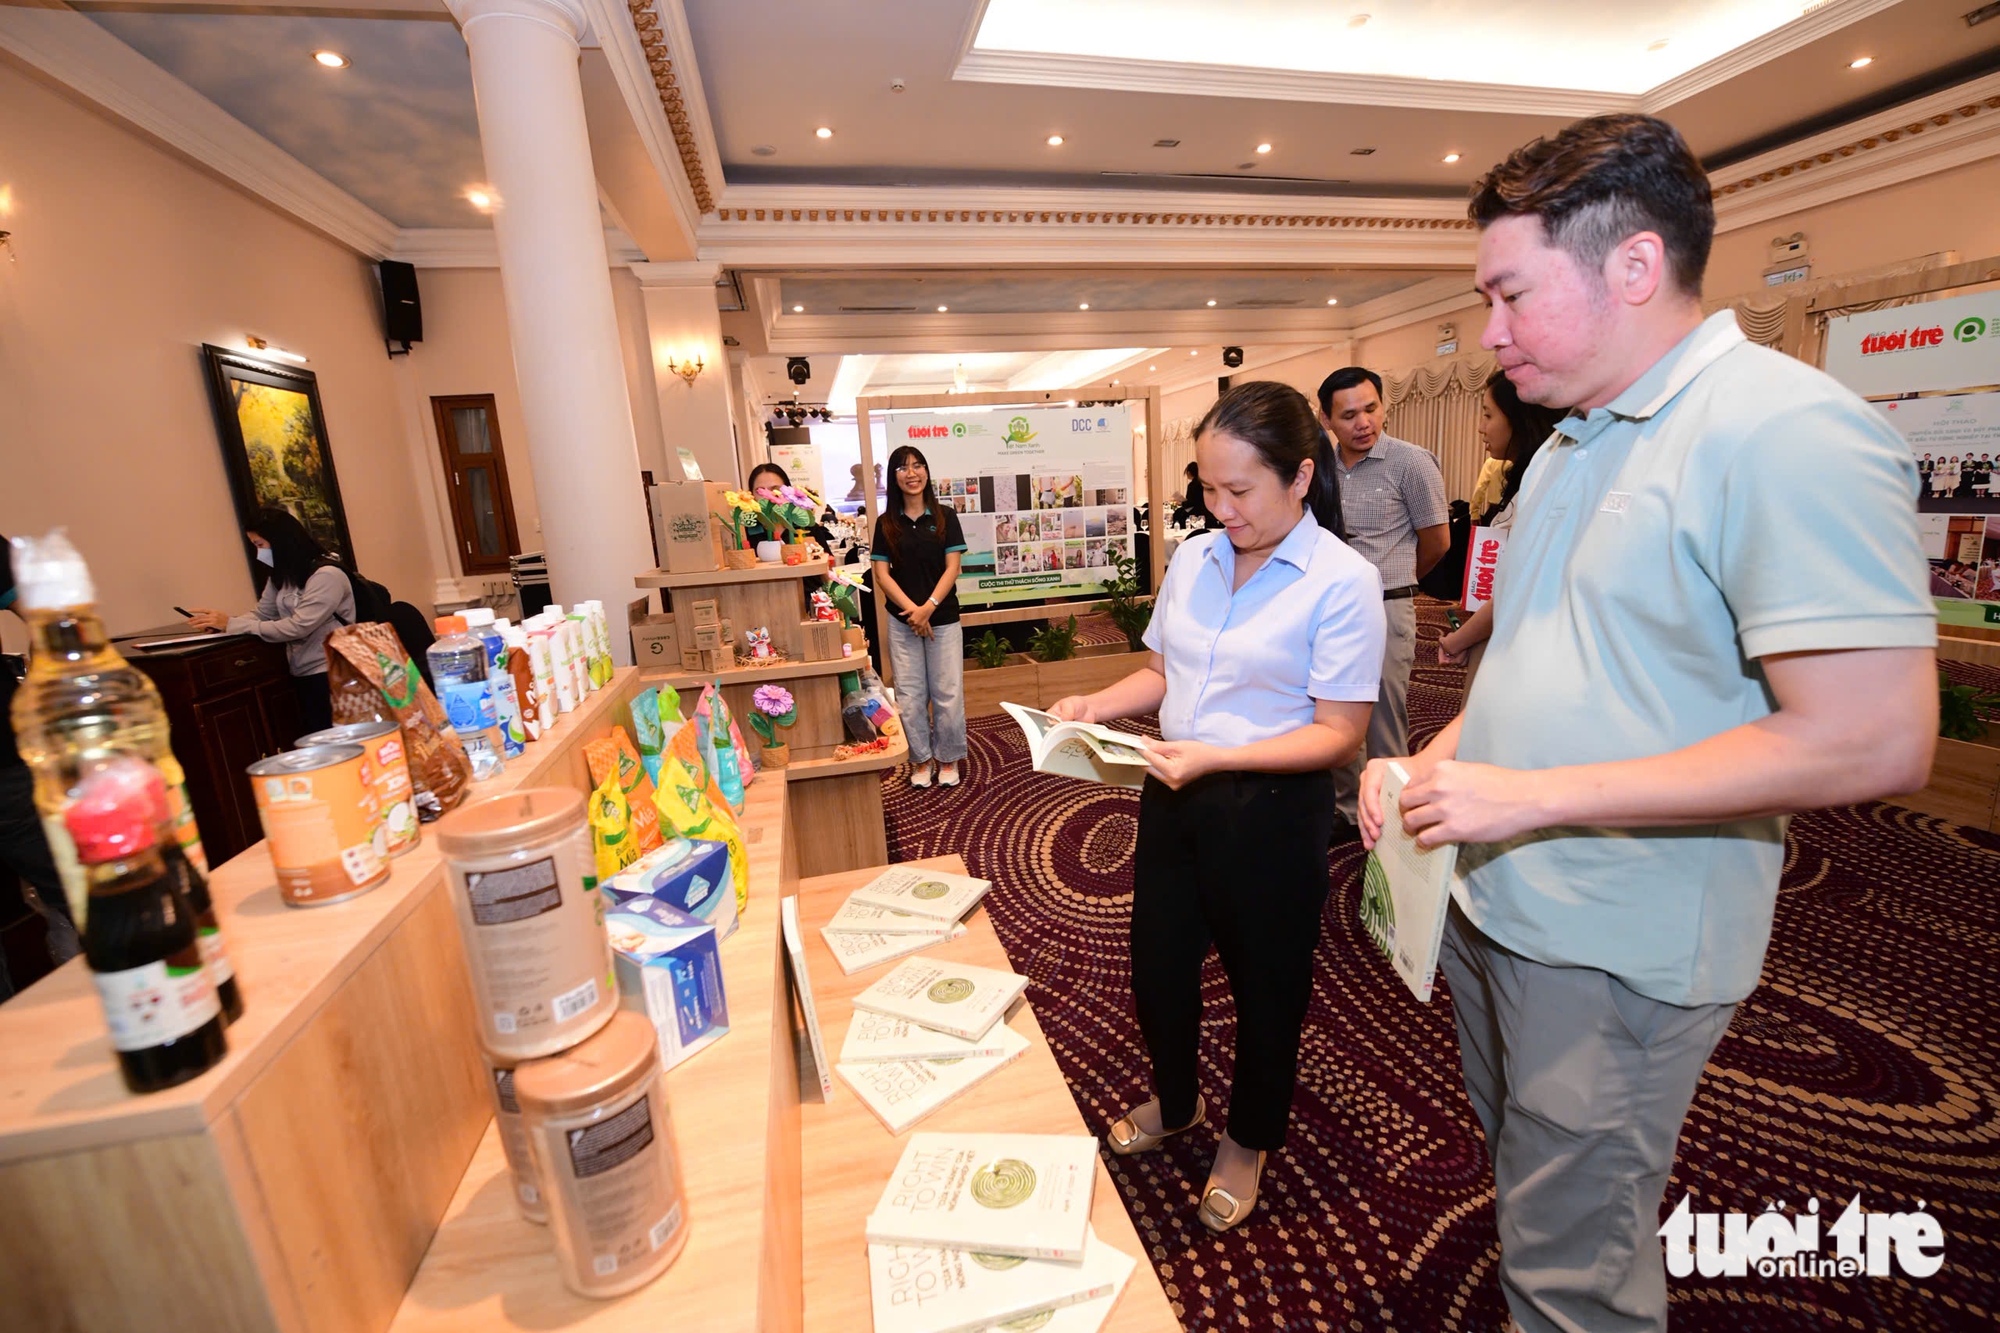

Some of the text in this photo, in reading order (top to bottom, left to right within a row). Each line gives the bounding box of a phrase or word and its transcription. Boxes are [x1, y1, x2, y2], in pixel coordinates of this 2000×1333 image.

[1071, 418, 1092, 432] DCC
[892, 1150, 932, 1207] RIGHT
[909, 1187, 937, 1215] TO
[887, 1244, 914, 1306] RIGH
